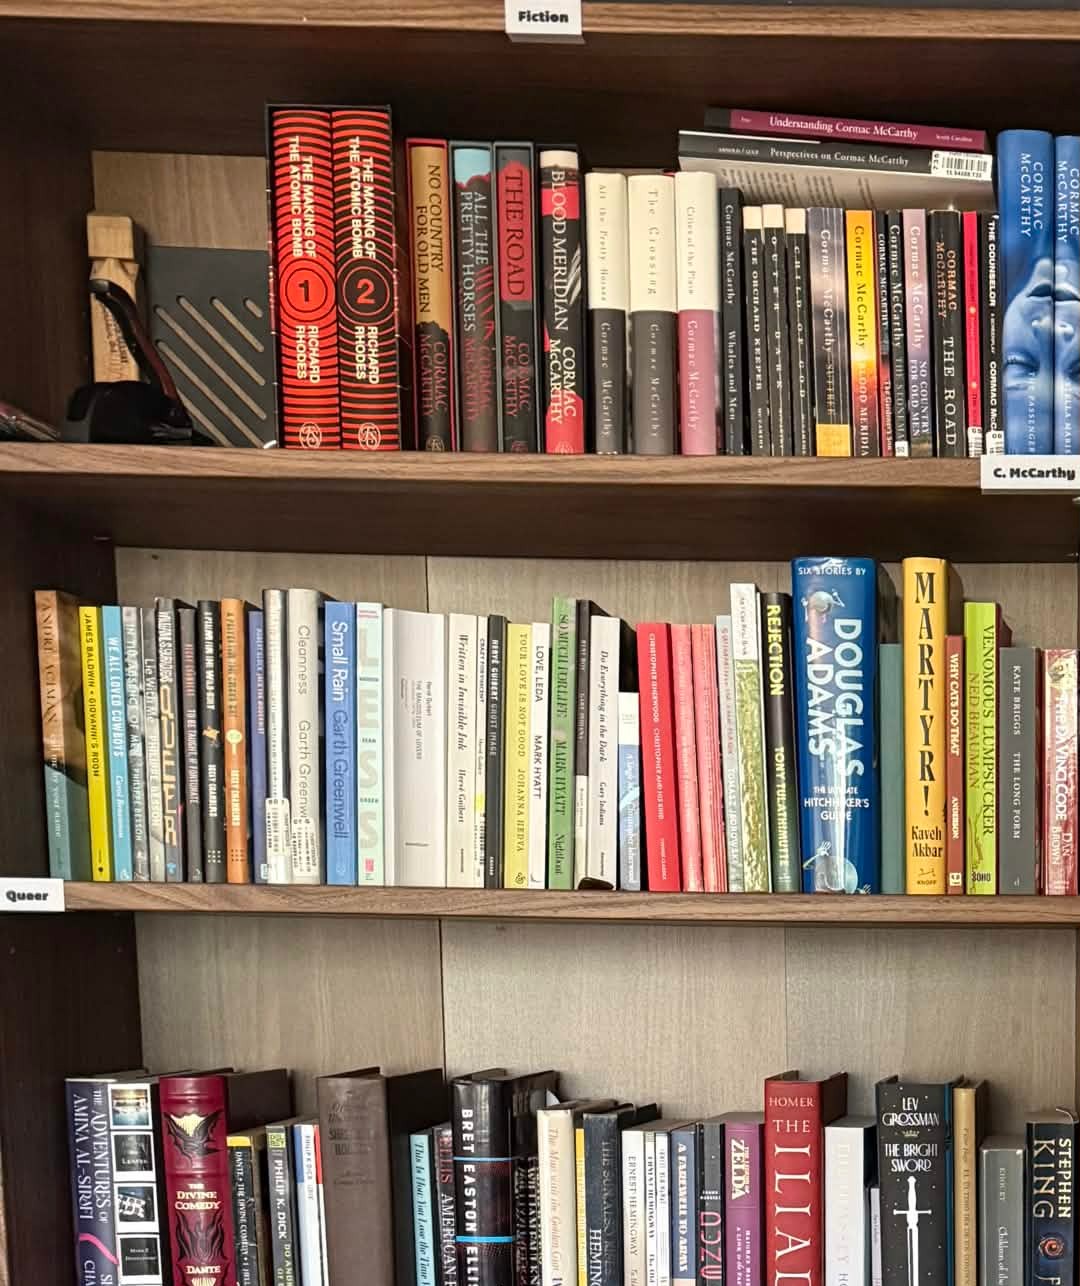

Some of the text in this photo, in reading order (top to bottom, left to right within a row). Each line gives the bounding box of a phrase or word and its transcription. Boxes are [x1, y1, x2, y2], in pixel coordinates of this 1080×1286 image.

[518, 10, 568, 23] Fiction
[770, 115, 918, 140] Understanding Cormac McCarthy
[770, 147, 818, 162] Perspectives
[834, 152, 866, 164] Cormac
[869, 154, 909, 166] McCarthy
[505, 169, 525, 295] THE ROAD
[552, 171, 568, 330] BLOOD MERIDIAN
[295, 327, 307, 380] RHODES
[307, 327, 320, 383] RICHARD
[550, 339, 563, 424] McCARTHY
[562, 347, 576, 416] CORMAC
[994, 465, 1075, 481] C. McCarthy
[798, 566, 866, 576] SIX STORIES BY
[767, 605, 784, 695] REJECTION
[298, 624, 311, 755] Cleanness Garth
[807, 638, 835, 756] ADAMS
[834, 618, 864, 777] DOUGLAS
[915, 572, 936, 818] MARTYR!
[331, 621, 349, 840] Small Rain Garth Greenwell
[982, 625, 994, 835] VENOMOUS LUMPSUCKER
[911, 825, 943, 842] Kaveh
[912, 843, 943, 859] Akbar
[7, 890, 48, 903] Queer
[770, 1097, 814, 1108] HOMER
[902, 1097, 918, 1110] LEV
[462, 1109, 473, 1153] BRET
[773, 1120, 810, 1132] THE
[882, 1113, 939, 1127] GROSSMAN
[885, 1144, 937, 1157] THE BRIGHT
[891, 1158, 931, 1173] SWORD
[177, 1190, 217, 1200] DIVINE
[1032, 1140, 1055, 1219] KING
[1058, 1138, 1072, 1218] STEPHEN
[175, 1201, 220, 1211] COMEDY
[463, 1164, 477, 1232] EASTON
[186, 1264, 220, 1274] DANTE
